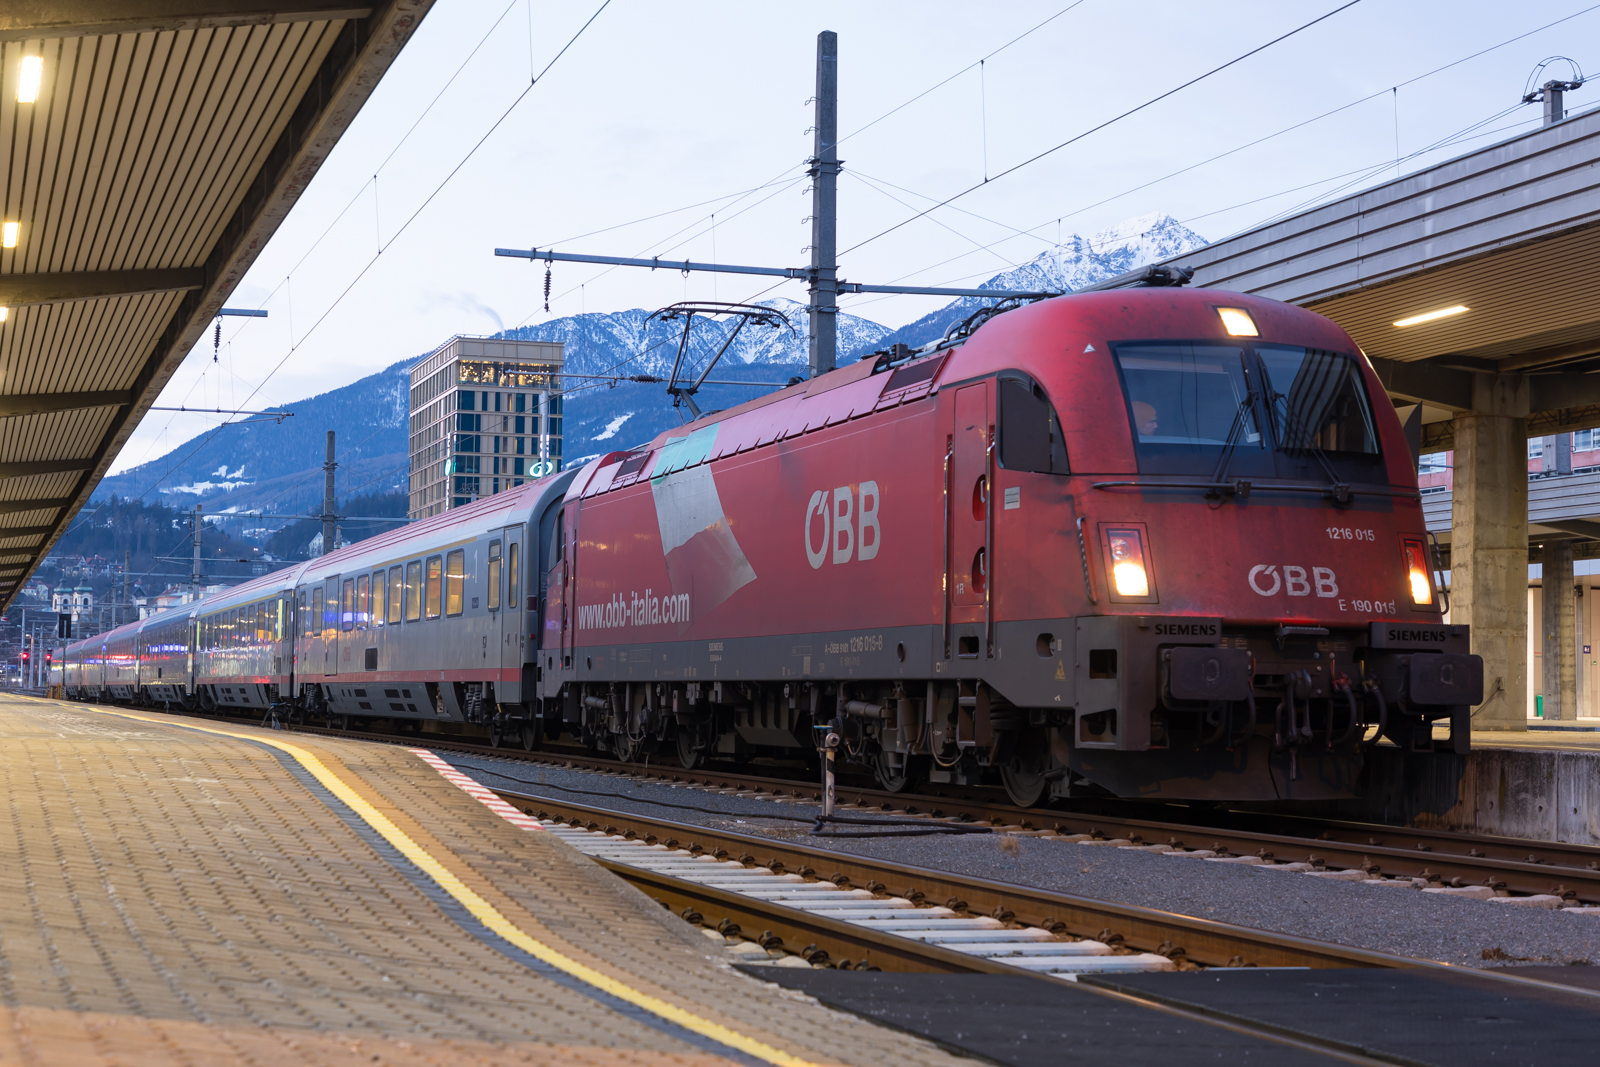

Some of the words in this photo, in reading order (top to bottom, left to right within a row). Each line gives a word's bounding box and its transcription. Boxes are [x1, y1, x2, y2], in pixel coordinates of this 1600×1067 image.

[805, 480, 881, 569] ÖBB
[1326, 527, 1353, 540] 1216
[1355, 528, 1375, 541] 015
[1248, 564, 1339, 598] ÖBB
[578, 588, 690, 630] www.obb-italia.com
[1338, 599, 1347, 611] E
[1351, 599, 1372, 612] 190
[1374, 599, 1396, 615] 015
[1155, 624, 1217, 636] SIEMENS
[1388, 629, 1446, 642] SIEMENS
[850, 636, 864, 652] 1216
[864, 634, 883, 651] 015-8
